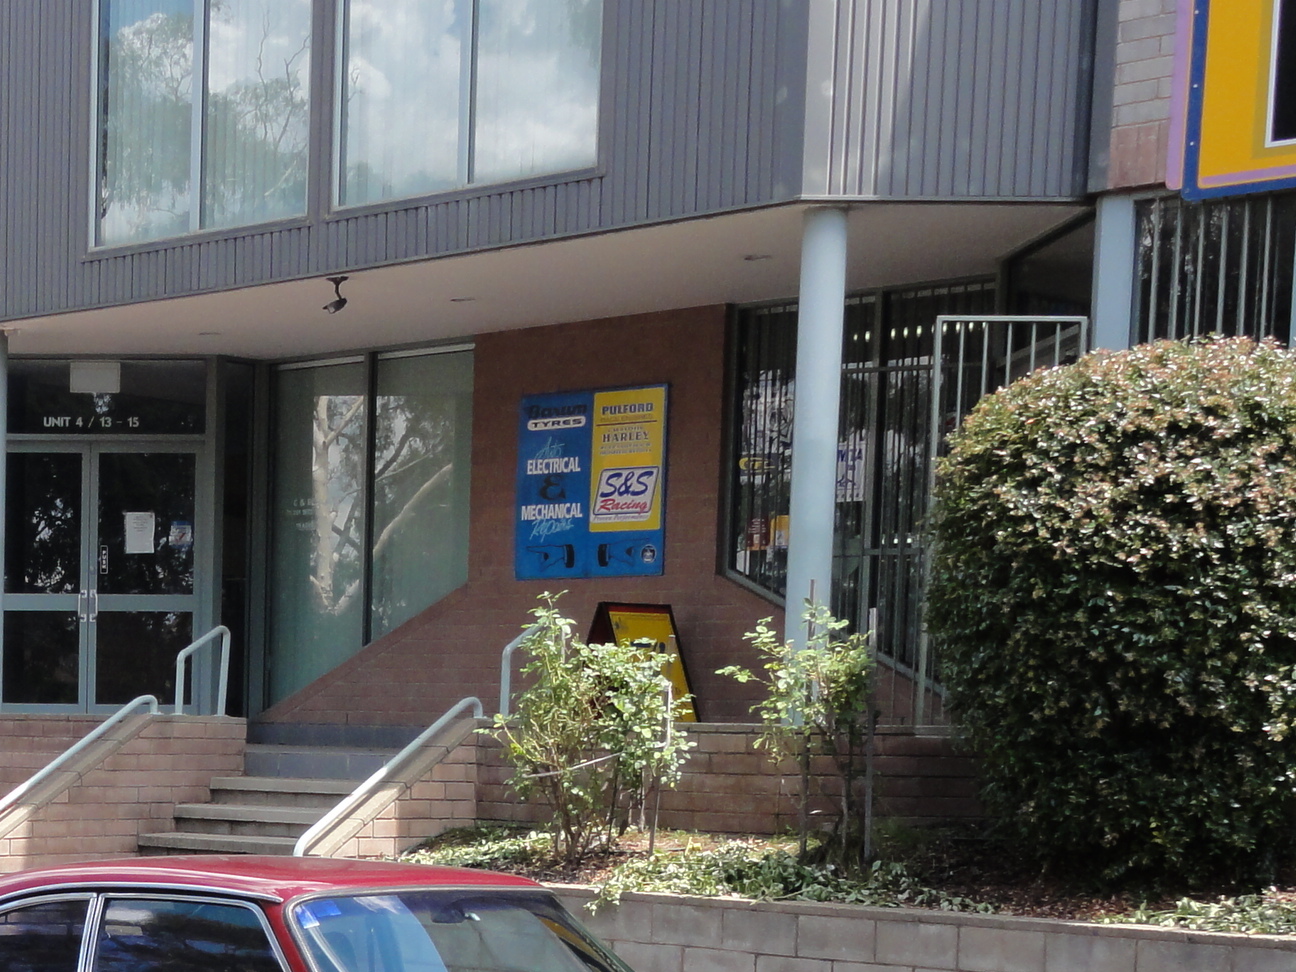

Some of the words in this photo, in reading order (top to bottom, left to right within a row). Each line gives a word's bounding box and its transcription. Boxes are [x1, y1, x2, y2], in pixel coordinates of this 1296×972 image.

[601, 402, 654, 416] PULFORD
[43, 416, 71, 428] UNIT
[75, 416, 83, 428] 4
[99, 416, 112, 428] 13
[127, 416, 140, 428] 15
[533, 418, 583, 429] TYRES
[602, 431, 650, 443] HARLEY
[527, 456, 582, 475] ELECTRICAL
[599, 470, 655, 499] S&S
[521, 502, 584, 521] MECHANICAL
[598, 498, 649, 515] Racing
